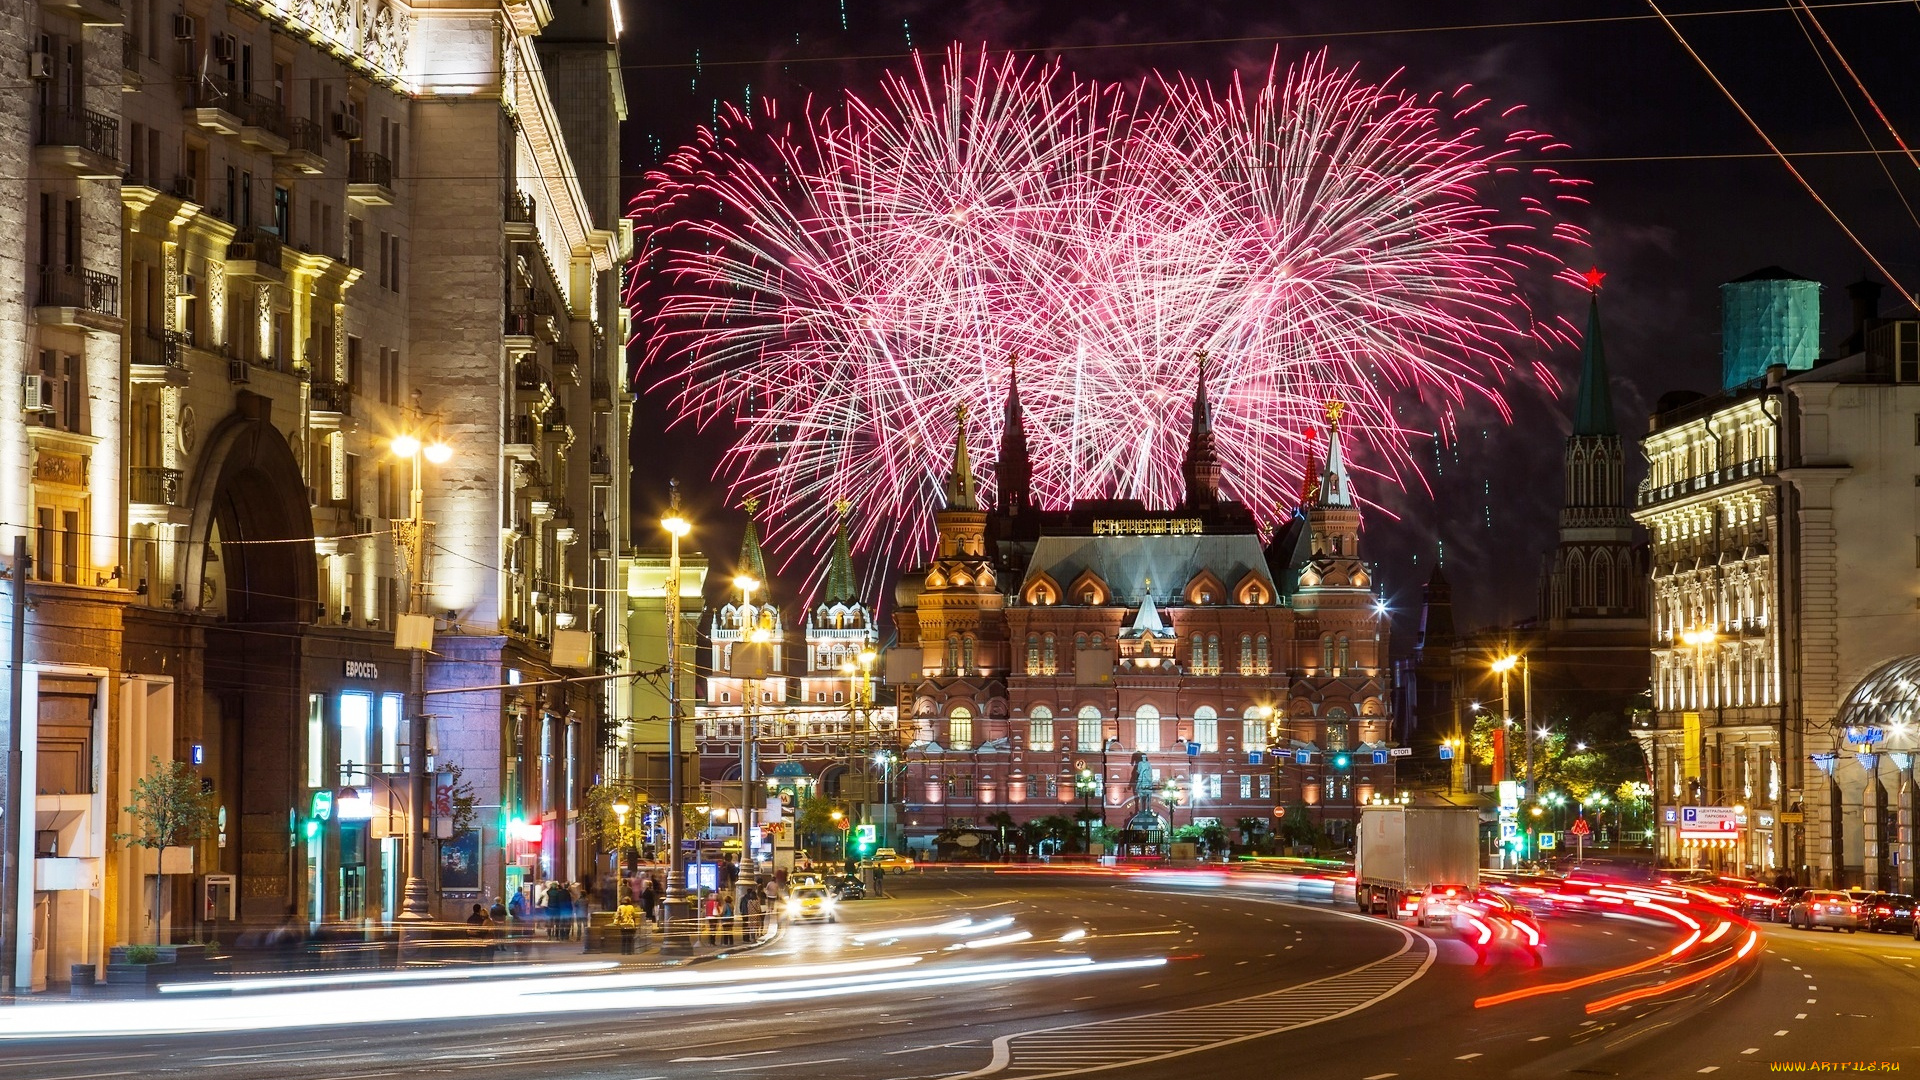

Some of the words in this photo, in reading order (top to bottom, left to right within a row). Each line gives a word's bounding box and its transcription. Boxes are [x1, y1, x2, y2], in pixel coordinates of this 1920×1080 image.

[345, 660, 378, 679] ЕВРОСЕТЬ
[1686, 810, 1695, 820] P
[1572, 819, 1590, 835] М
